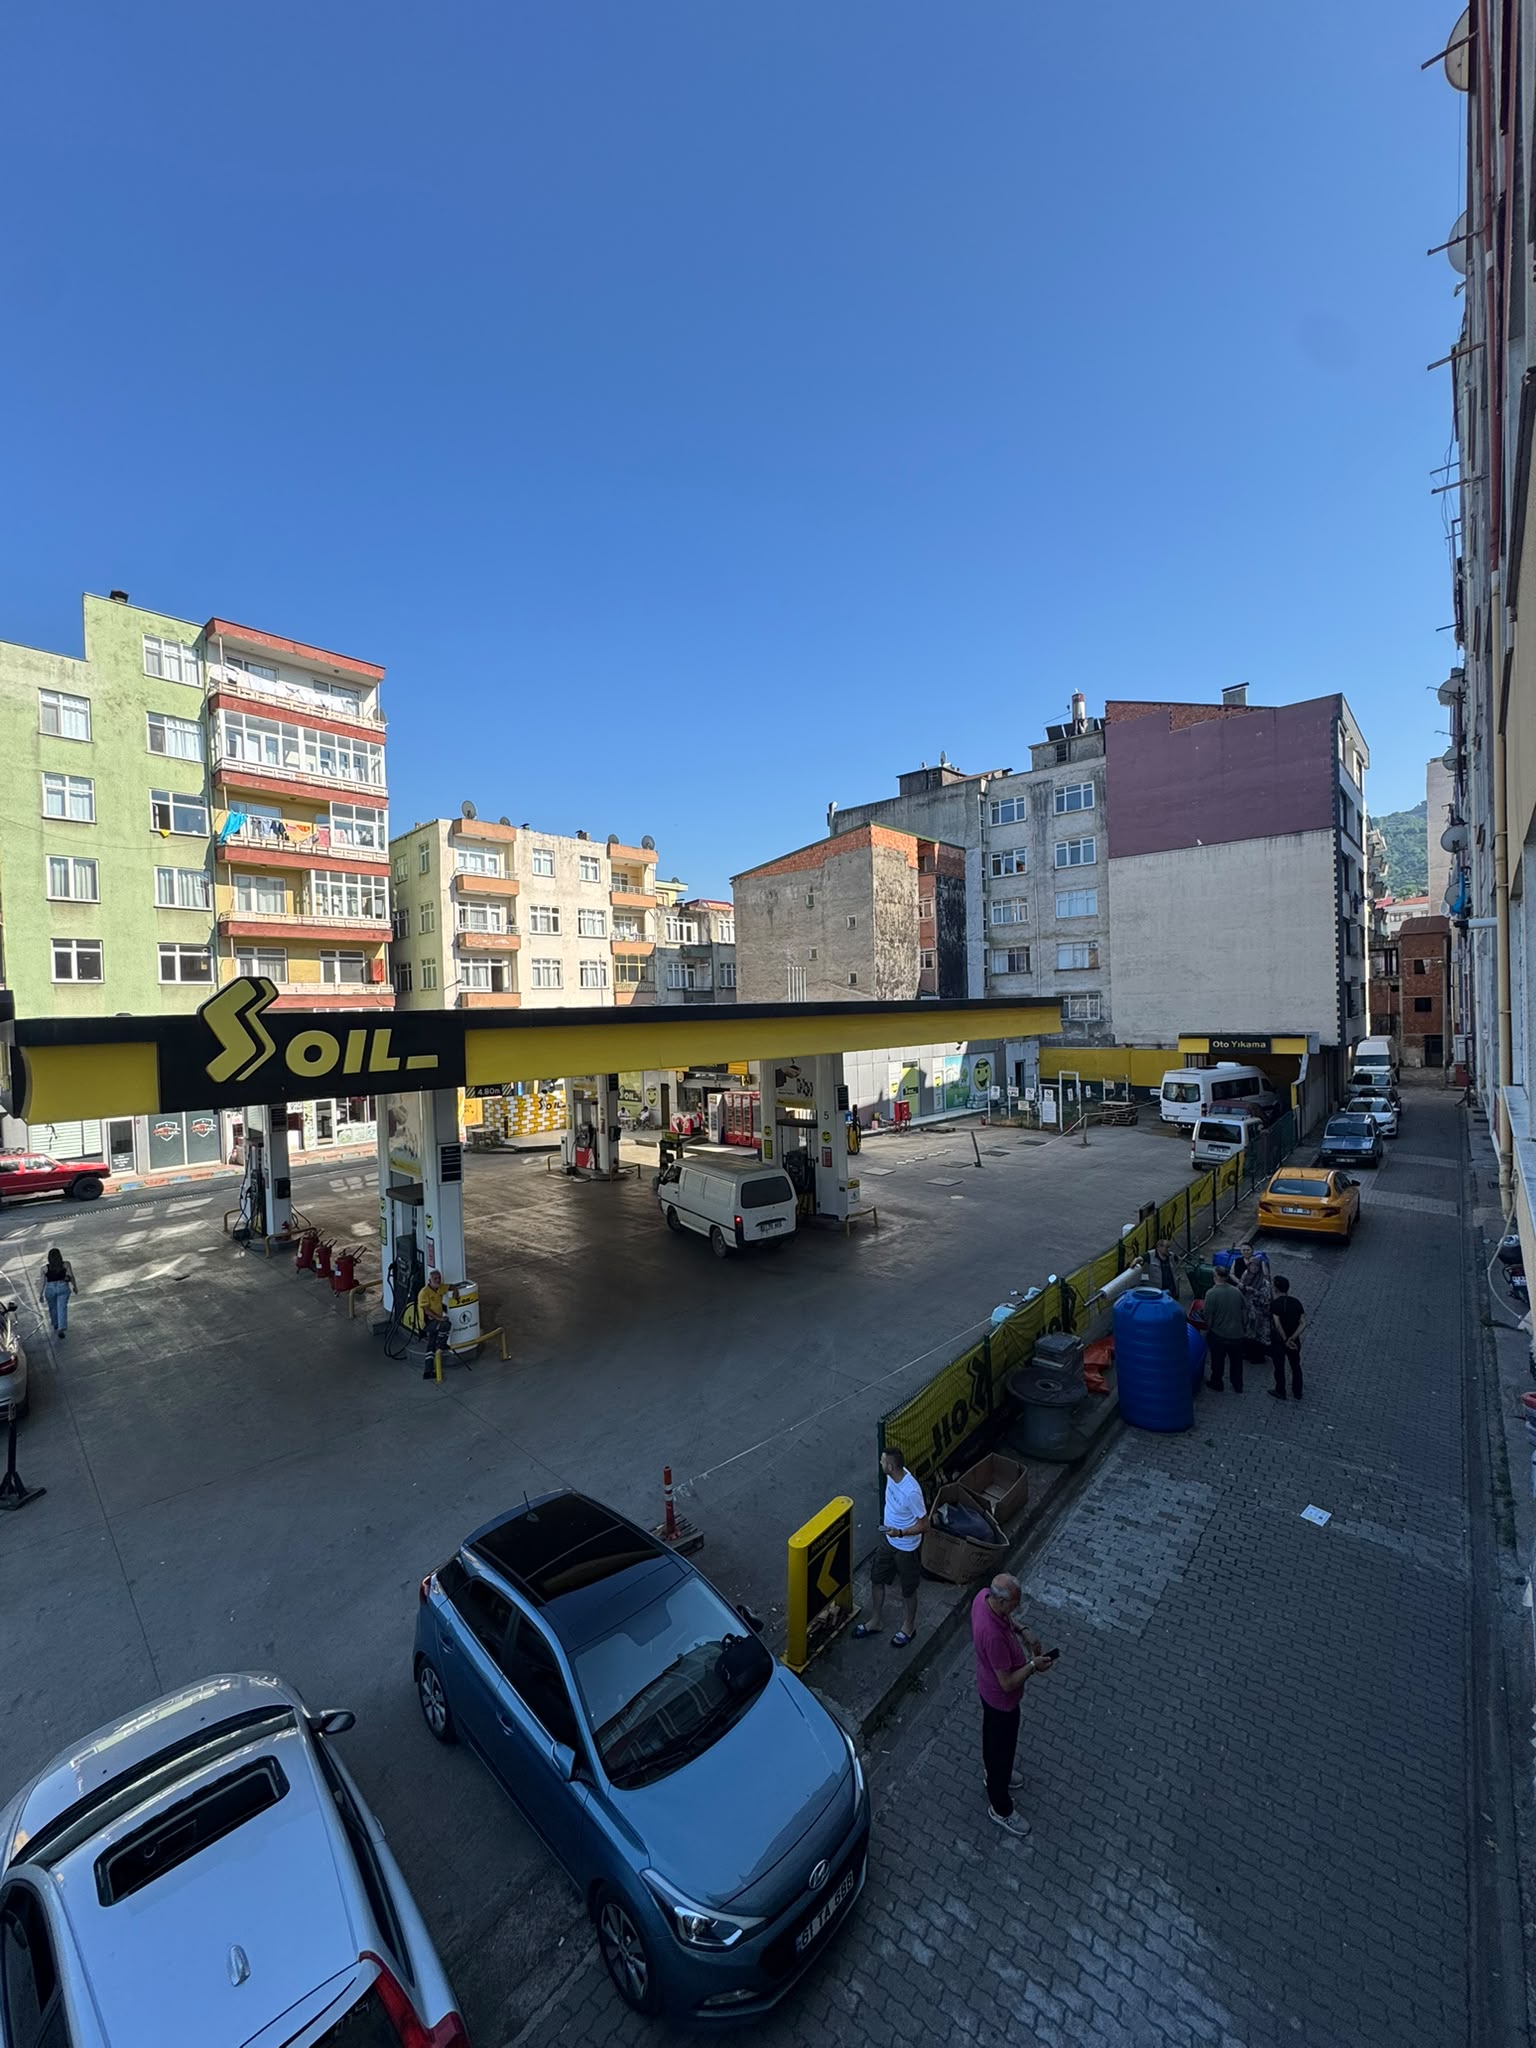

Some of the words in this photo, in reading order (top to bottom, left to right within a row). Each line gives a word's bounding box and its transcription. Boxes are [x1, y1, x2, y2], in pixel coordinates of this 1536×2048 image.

[1212, 1040, 1230, 1049] Oto
[1231, 1040, 1267, 1049] Yıkama
[823, 1110, 830, 1121] 5
